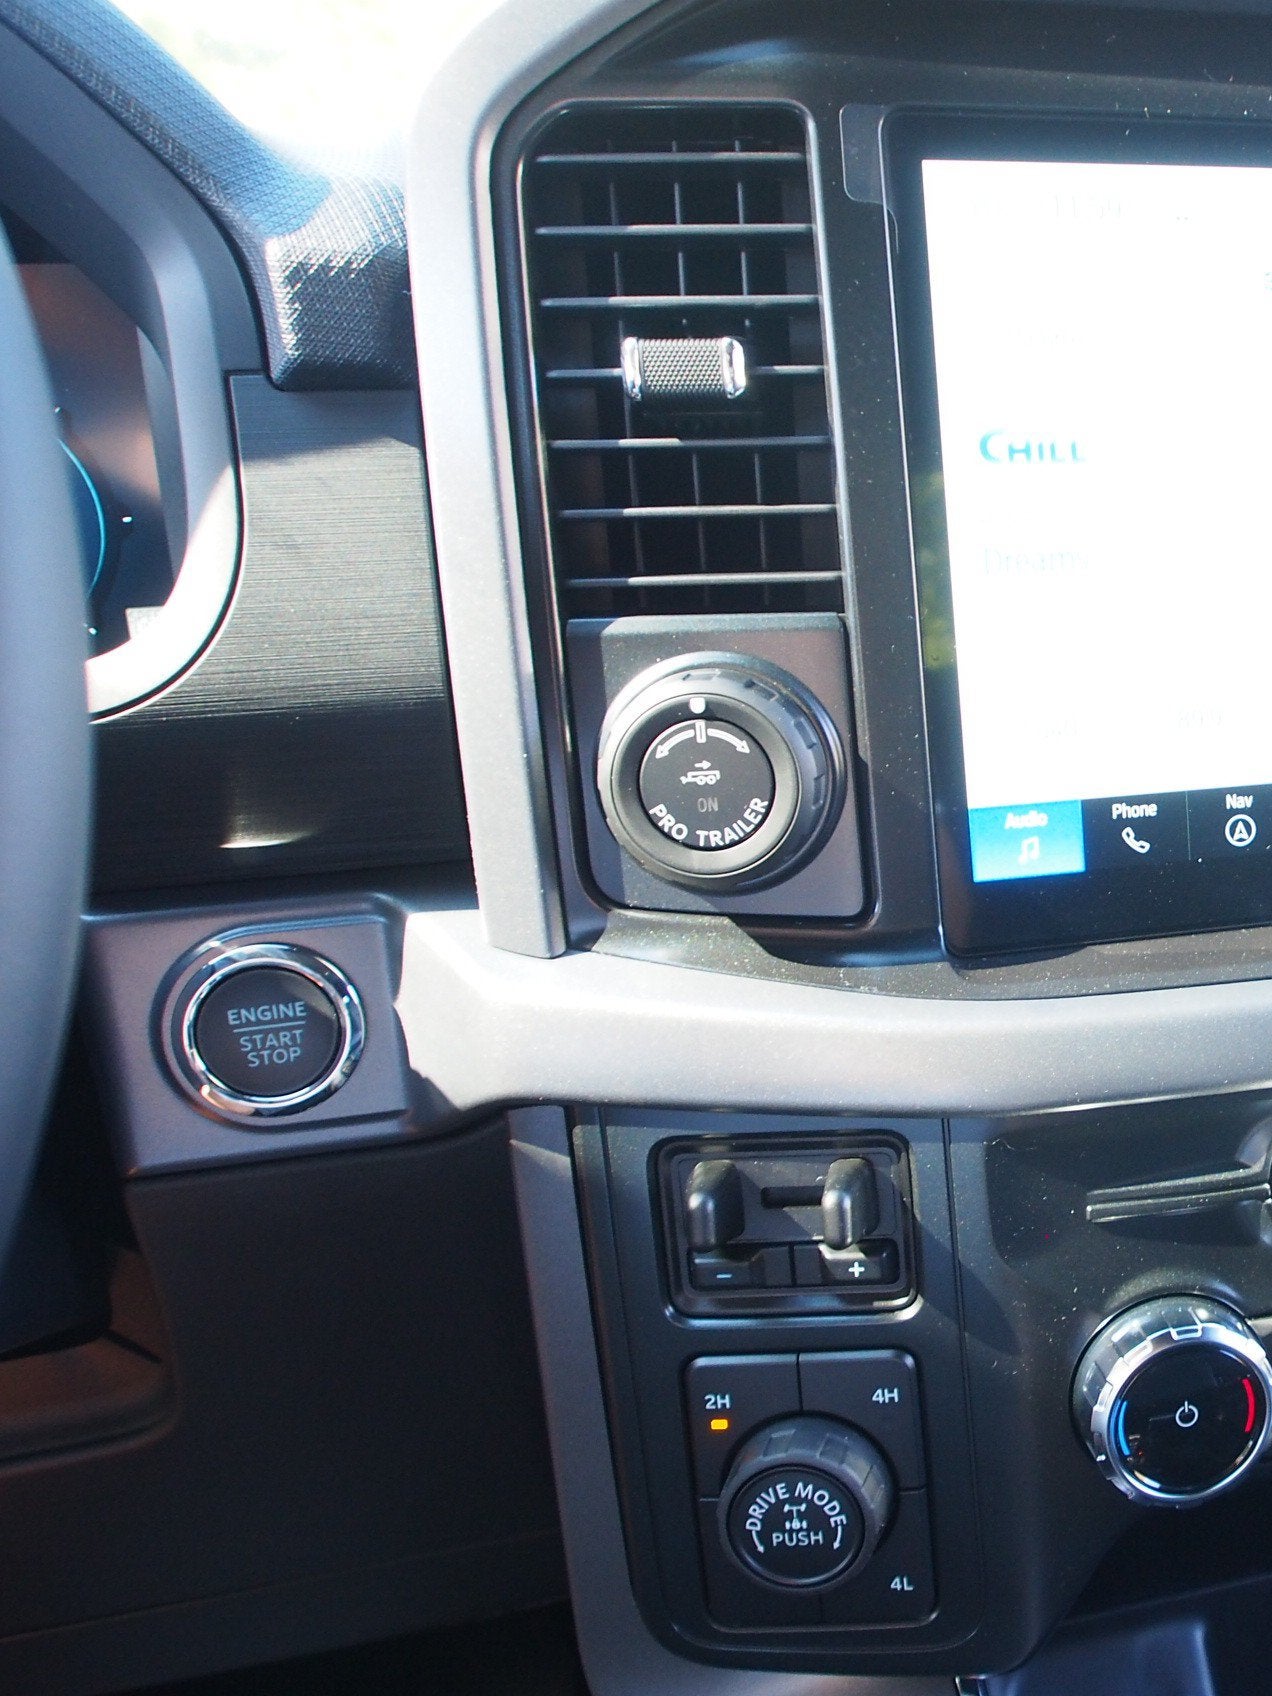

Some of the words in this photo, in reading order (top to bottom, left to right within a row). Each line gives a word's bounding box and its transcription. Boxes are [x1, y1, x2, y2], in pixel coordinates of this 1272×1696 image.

[696, 797, 719, 814] ON
[1111, 802, 1158, 820] Phone
[1225, 794, 1253, 810] Nav
[649, 803, 689, 841] PRO
[695, 797, 769, 848] TRAILER
[1004, 811, 1049, 831] Audio
[227, 1000, 307, 1025] ENGINE
[239, 1029, 304, 1051] START
[247, 1047, 302, 1068] STOP
[704, 1393, 731, 1410] 2H
[871, 1387, 899, 1405] 4H
[746, 1482, 789, 1532] DRIVE
[795, 1481, 847, 1528] MODE
[772, 1531, 824, 1547] PUSH
[890, 1576, 914, 1592] 4L
